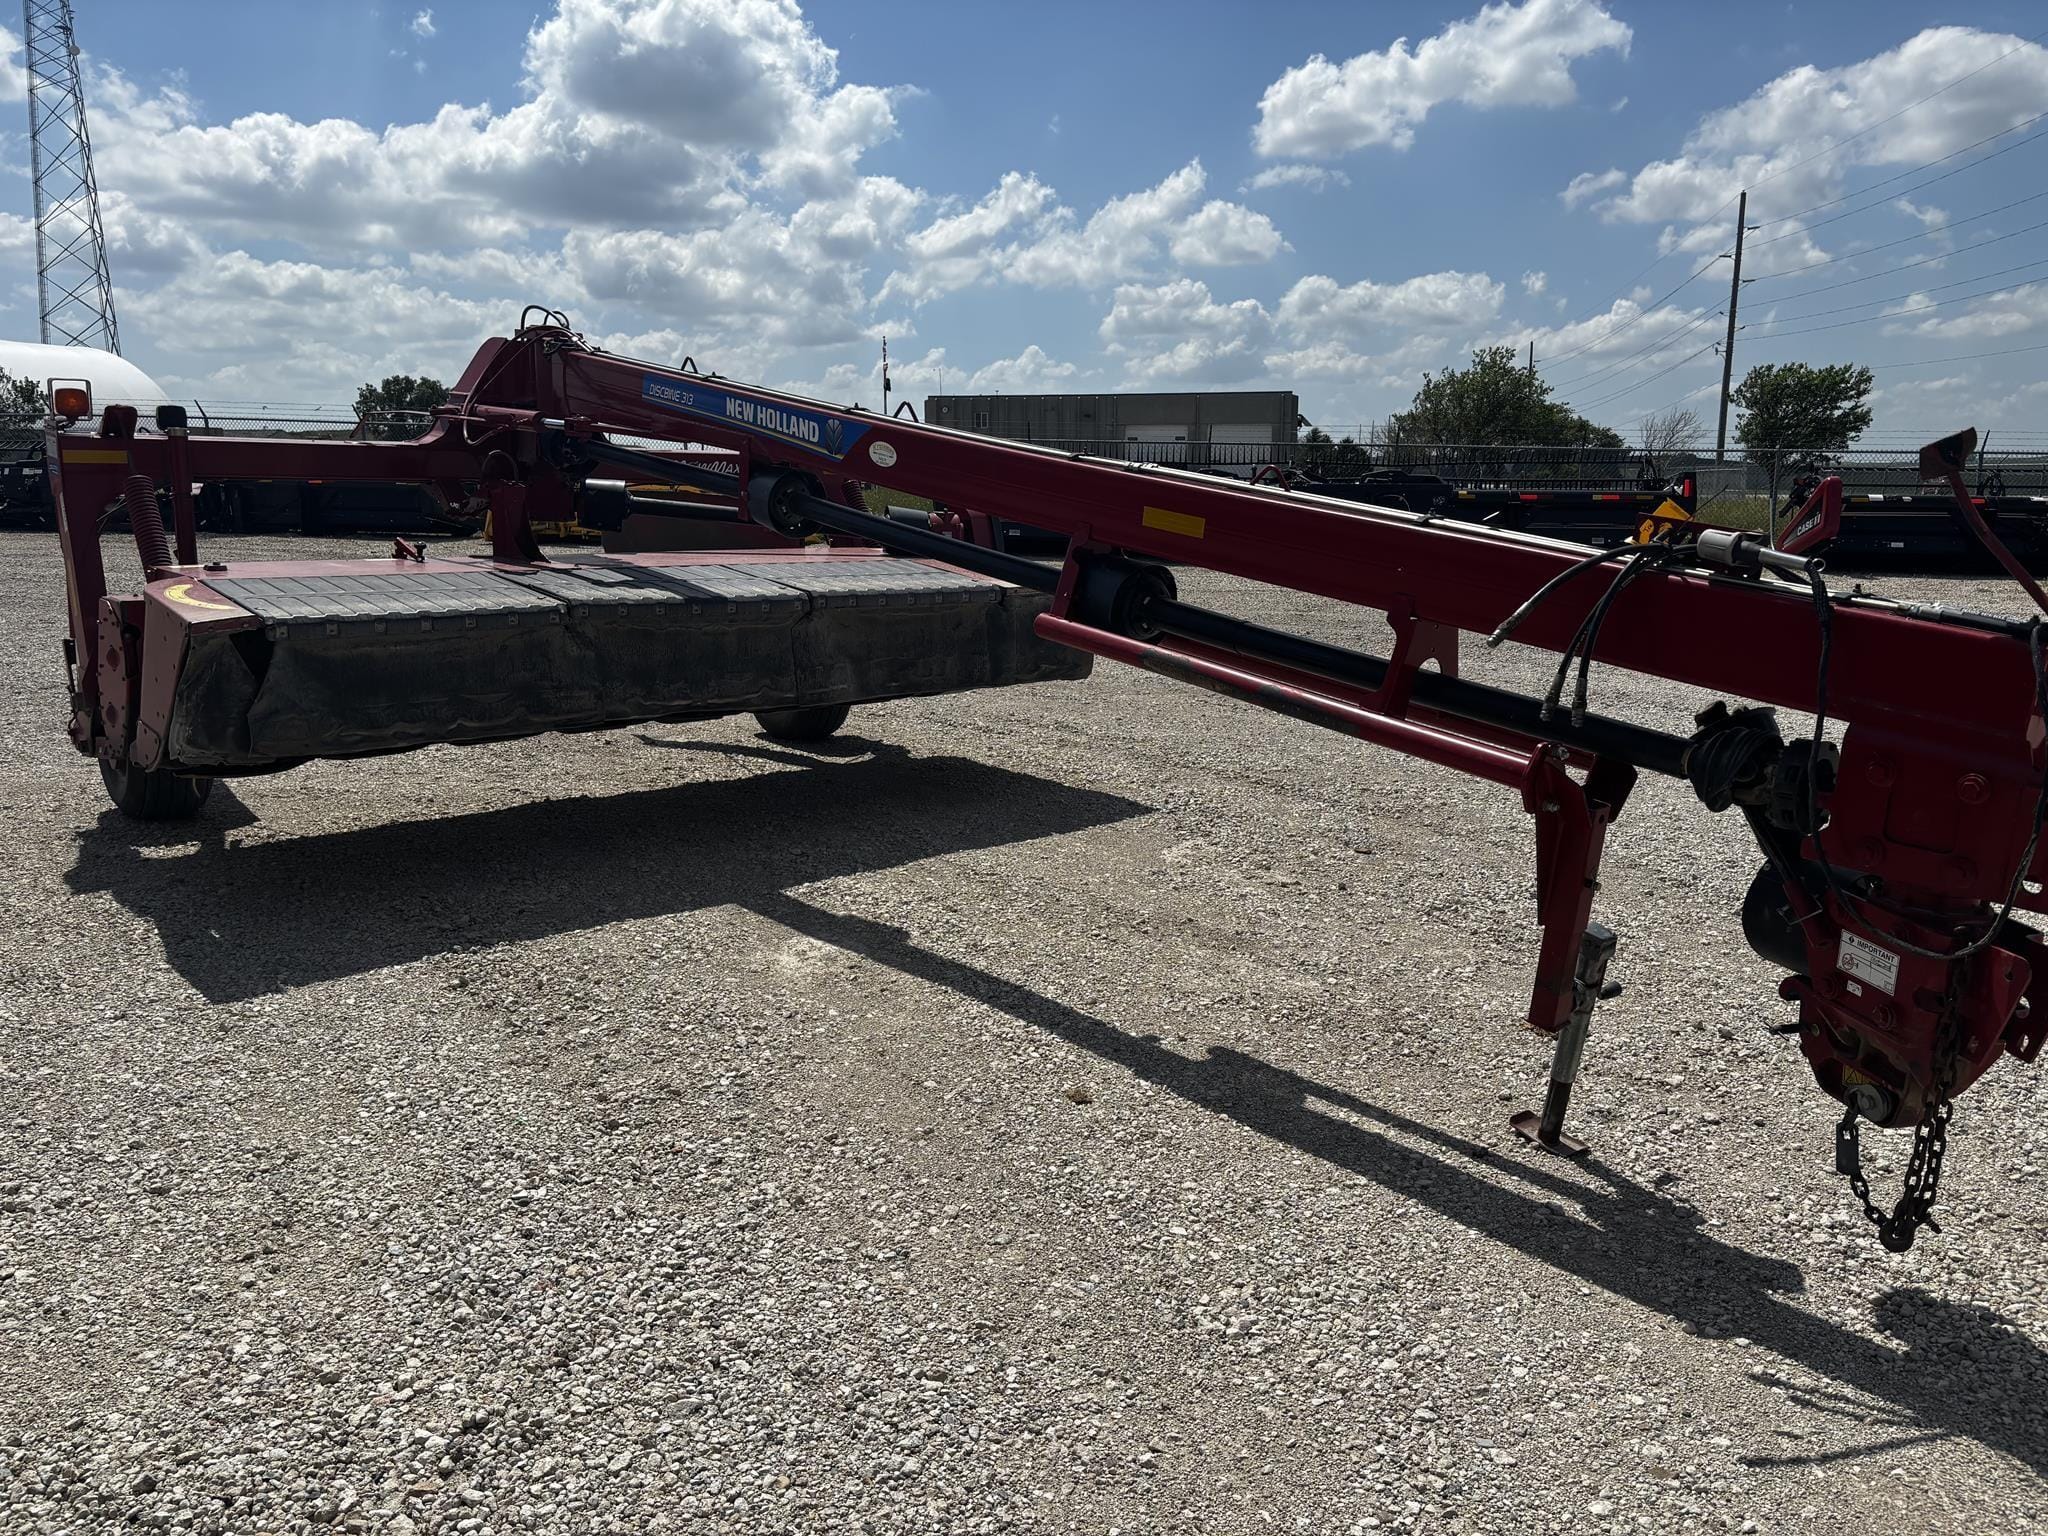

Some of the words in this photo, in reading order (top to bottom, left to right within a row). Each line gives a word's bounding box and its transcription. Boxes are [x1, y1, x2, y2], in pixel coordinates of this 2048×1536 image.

[649, 383, 680, 402] DISCBINE
[681, 391, 694, 406] 313
[726, 396, 754, 423] NEW
[757, 405, 820, 443] HOLLAND
[1797, 518, 1814, 536] CASE
[1857, 940, 1895, 962] IMPORTANT
